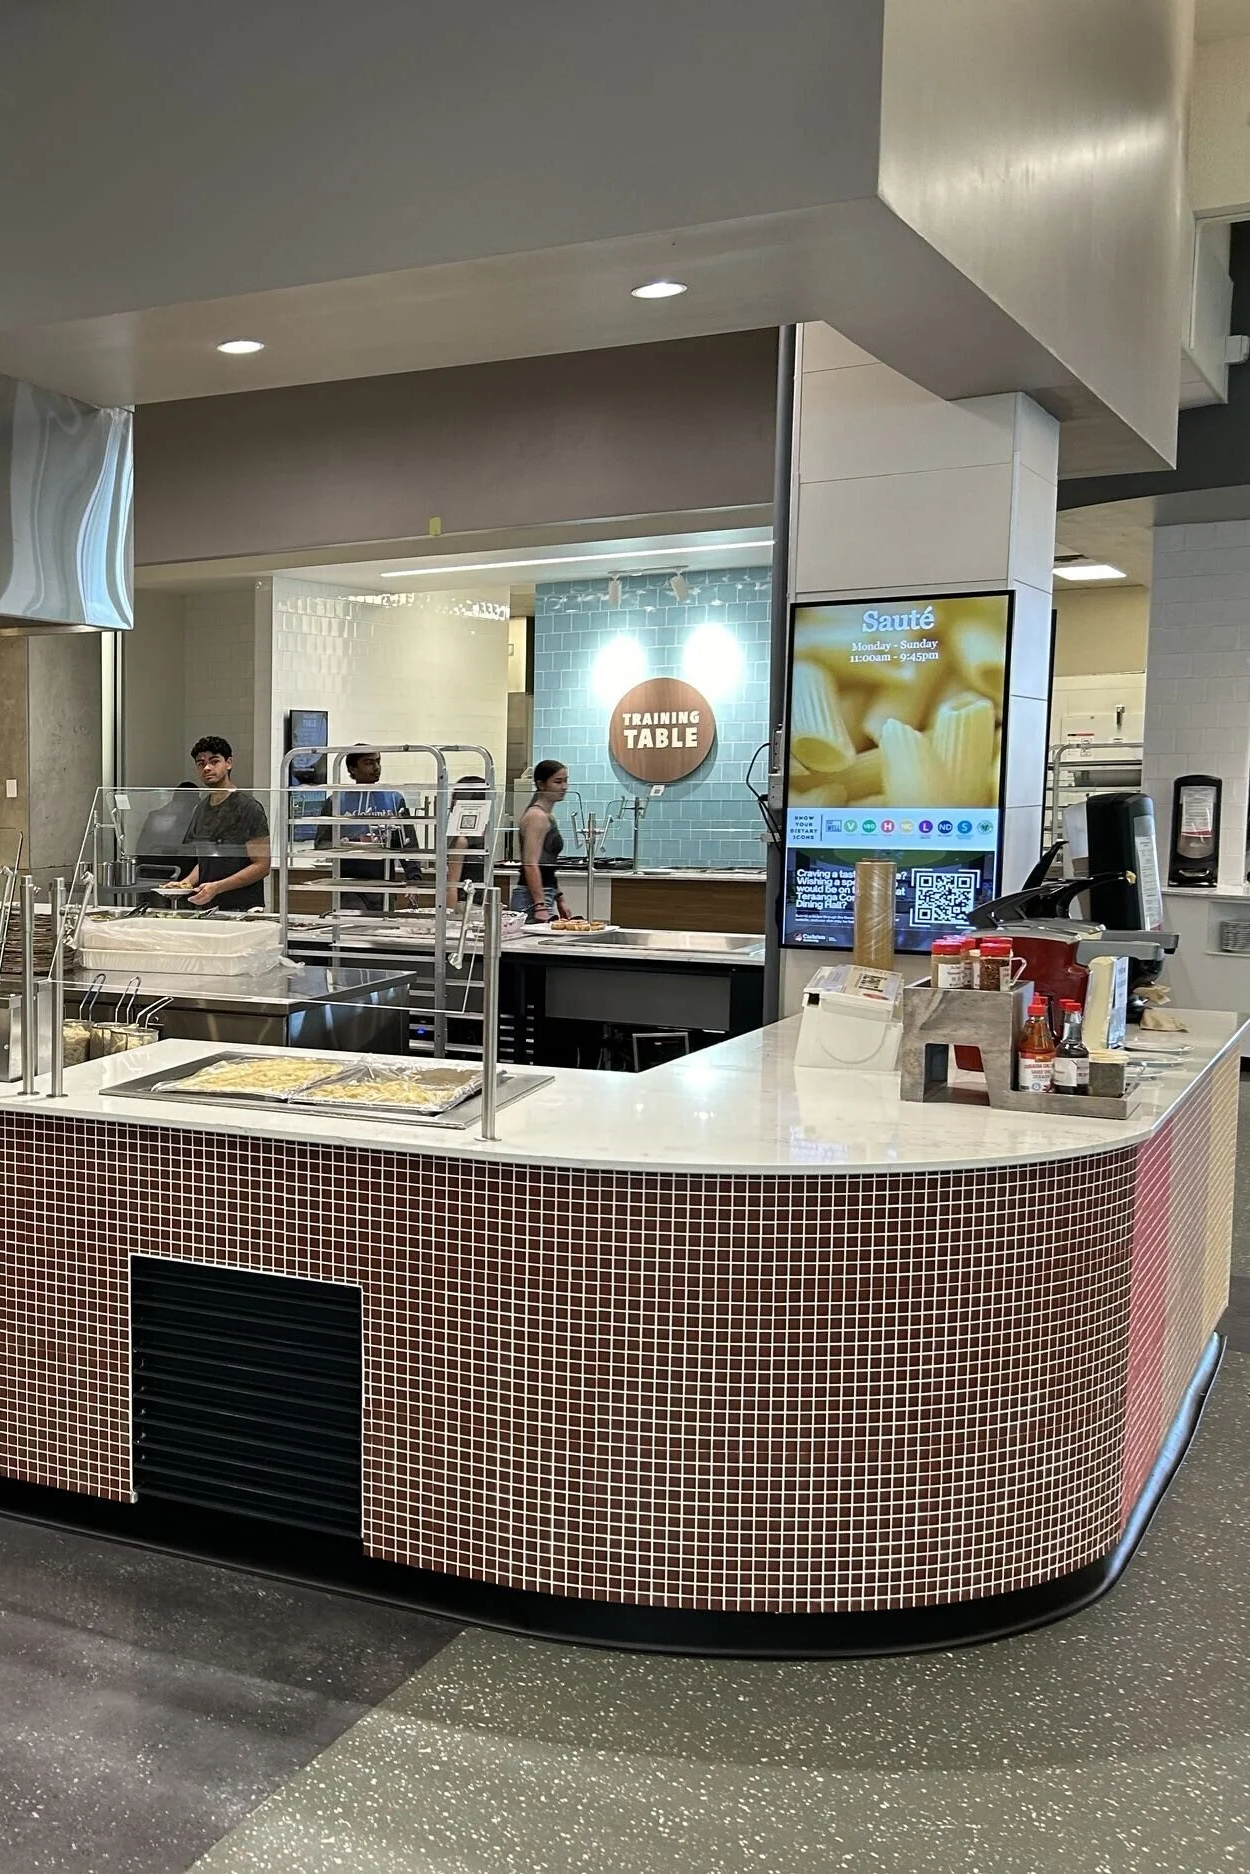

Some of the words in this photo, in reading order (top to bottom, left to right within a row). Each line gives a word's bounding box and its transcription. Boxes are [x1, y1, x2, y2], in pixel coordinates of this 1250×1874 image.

[862, 605, 935, 632] Sauté
[852, 640, 892, 652] Monday
[900, 639, 939, 650] Sunday
[850, 653, 891, 663] 11:00am
[900, 651, 939, 662] 9:45pm
[622, 710, 700, 726] TRAINING
[623, 727, 698, 749] TABLE
[796, 869, 830, 879] Craving
[796, 877, 833, 887] Wishing
[796, 885, 824, 893] would
[825, 885, 837, 894] be
[895, 887, 906, 896] at
[796, 900, 823, 910] Dining
[824, 900, 848, 909] Hall?
